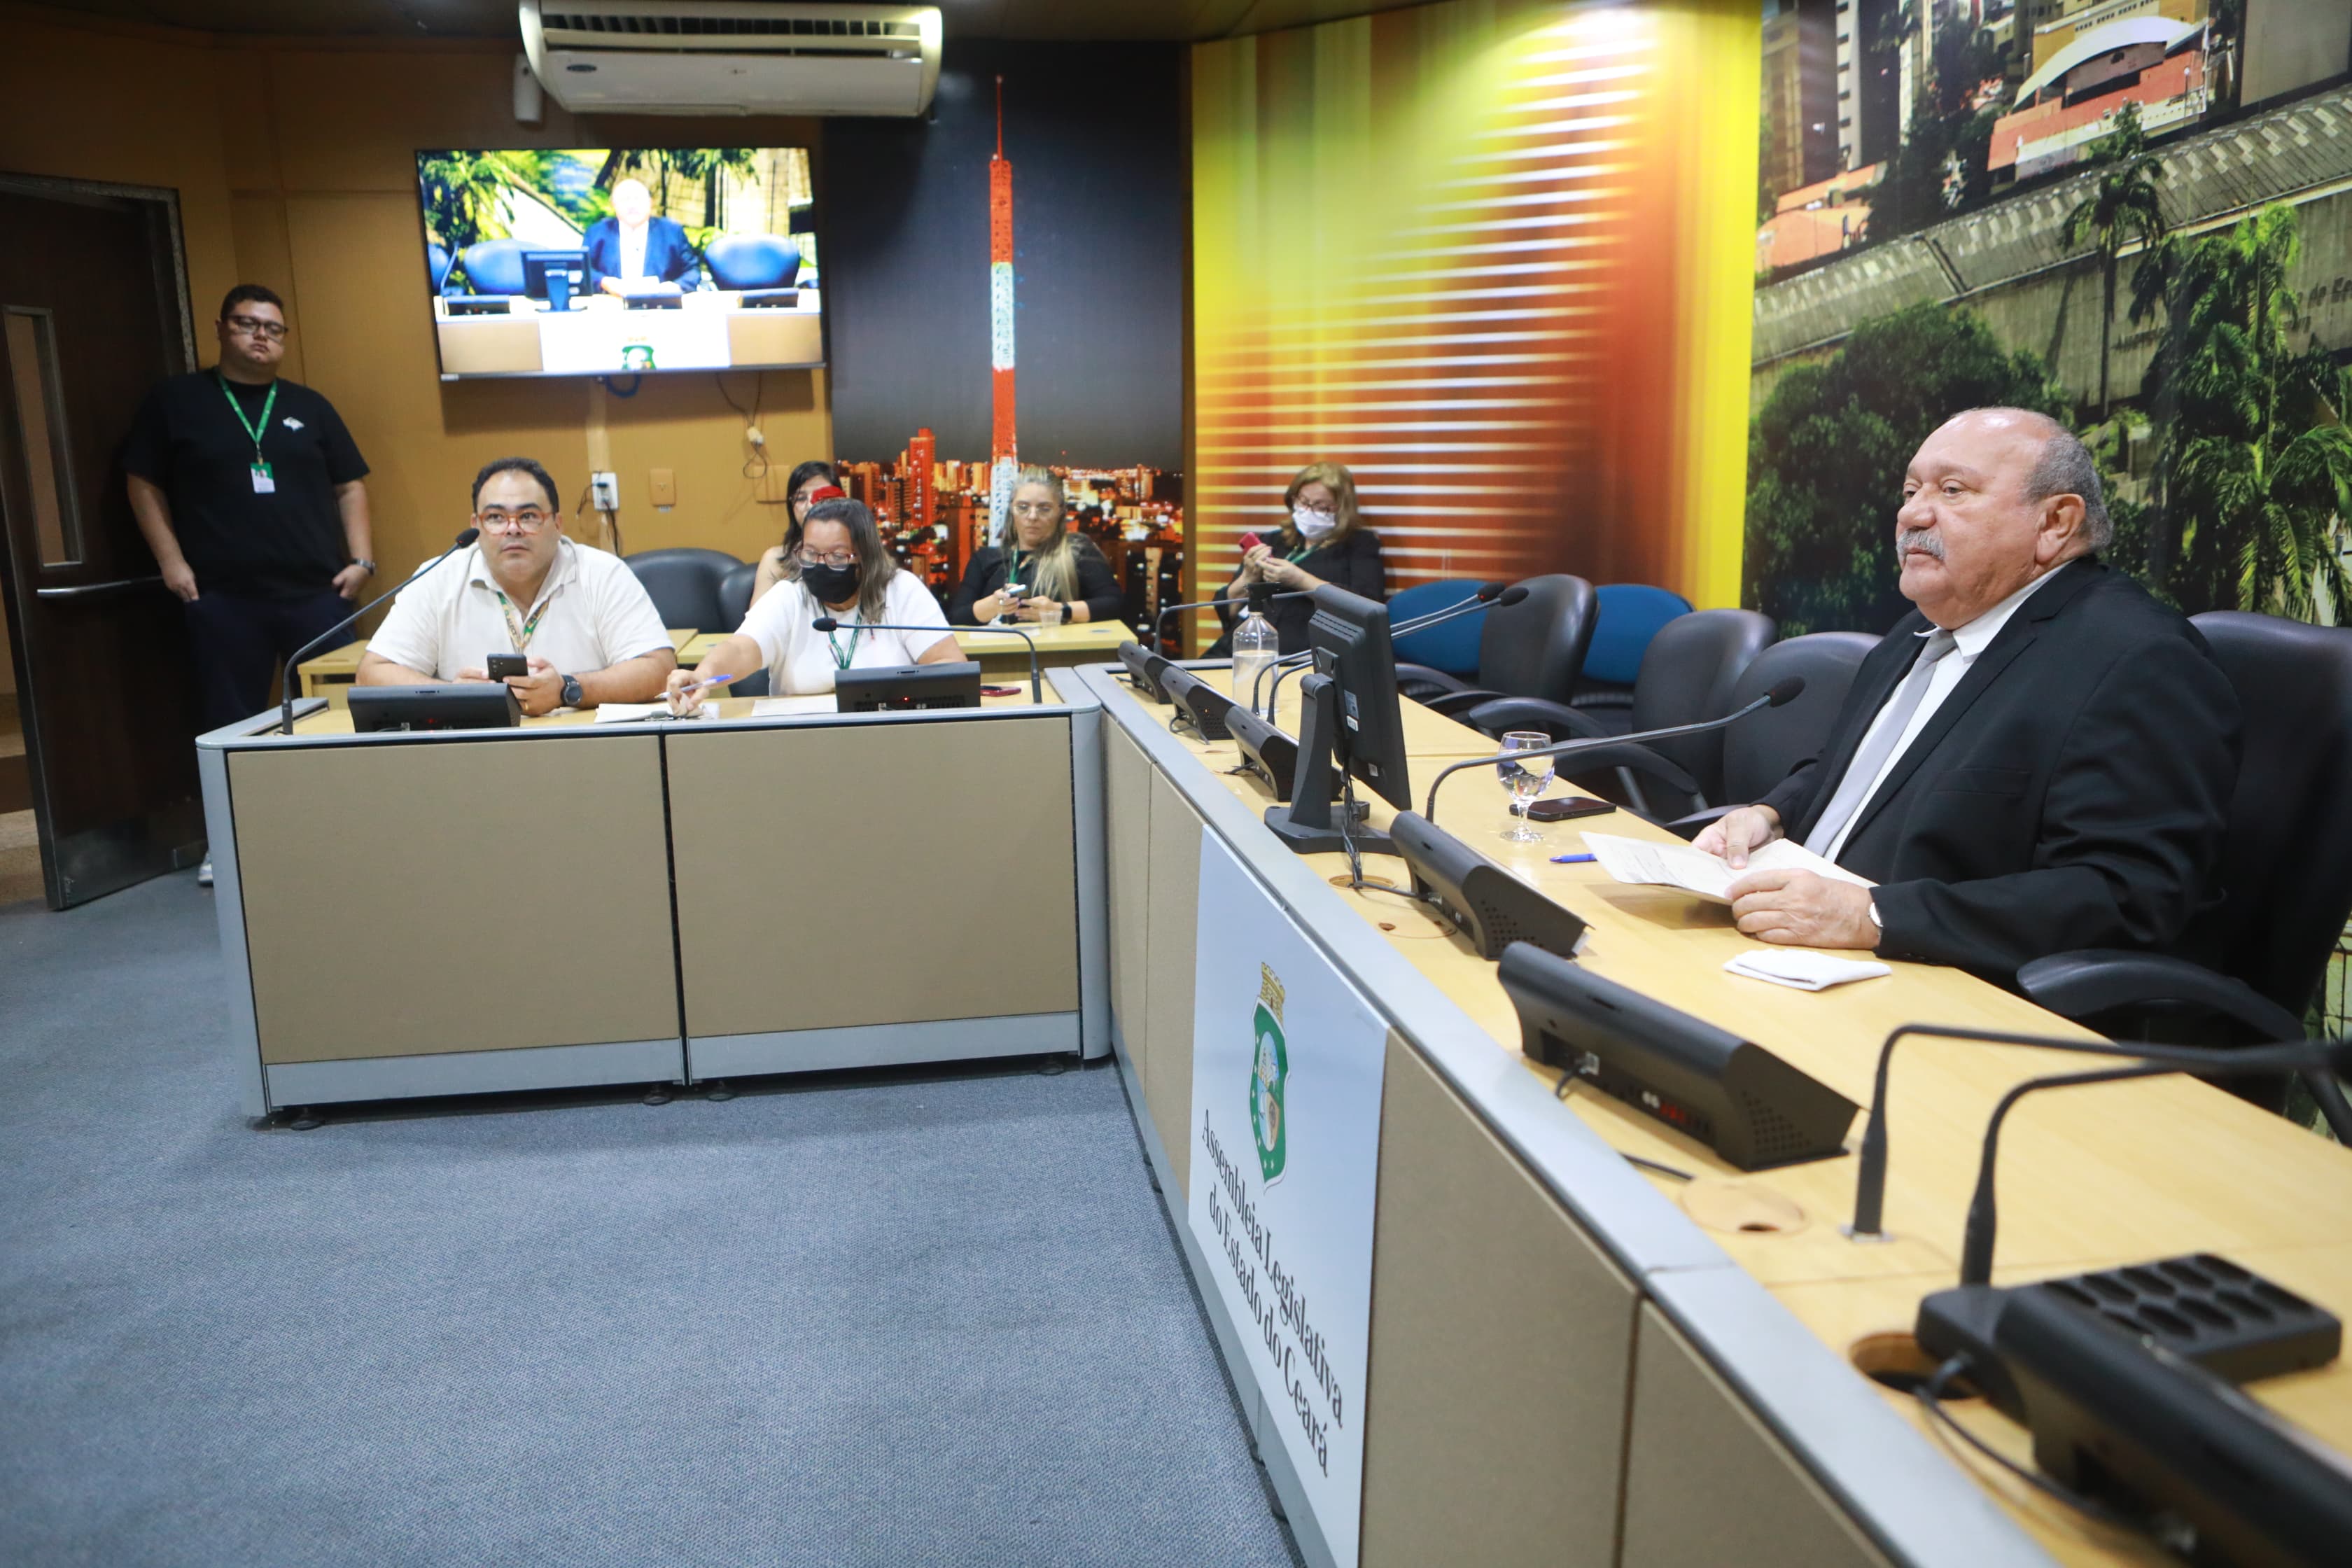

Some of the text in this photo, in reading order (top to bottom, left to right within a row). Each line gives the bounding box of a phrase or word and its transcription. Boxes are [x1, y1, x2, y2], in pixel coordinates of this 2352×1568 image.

[1202, 1108, 1343, 1429] Assembleia Legislativa
[1210, 1182, 1328, 1478] do Estado do Ceará
